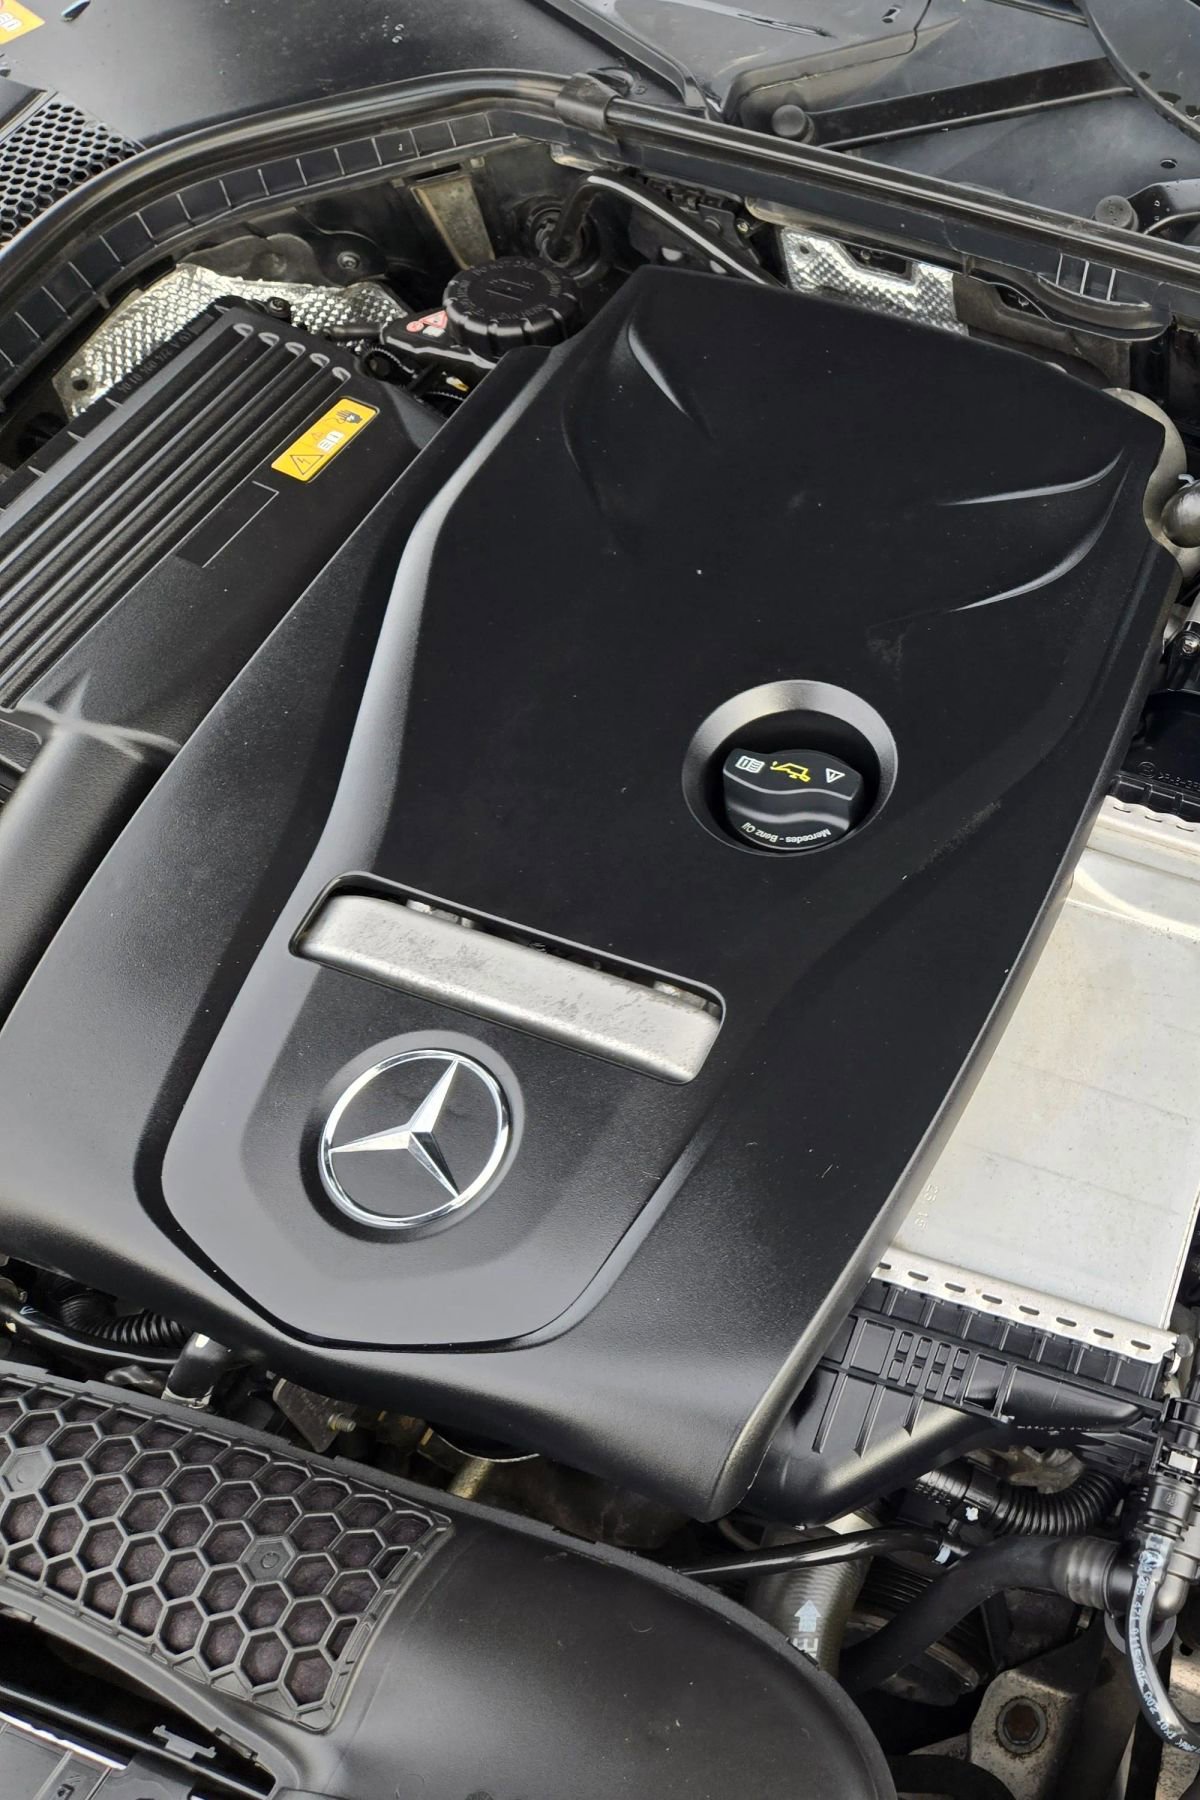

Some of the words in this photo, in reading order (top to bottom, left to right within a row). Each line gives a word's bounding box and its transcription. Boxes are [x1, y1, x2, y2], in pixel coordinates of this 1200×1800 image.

[741, 822, 756, 833] Oil
[754, 829, 779, 843] Benz
[785, 828, 832, 844] Mercedes
